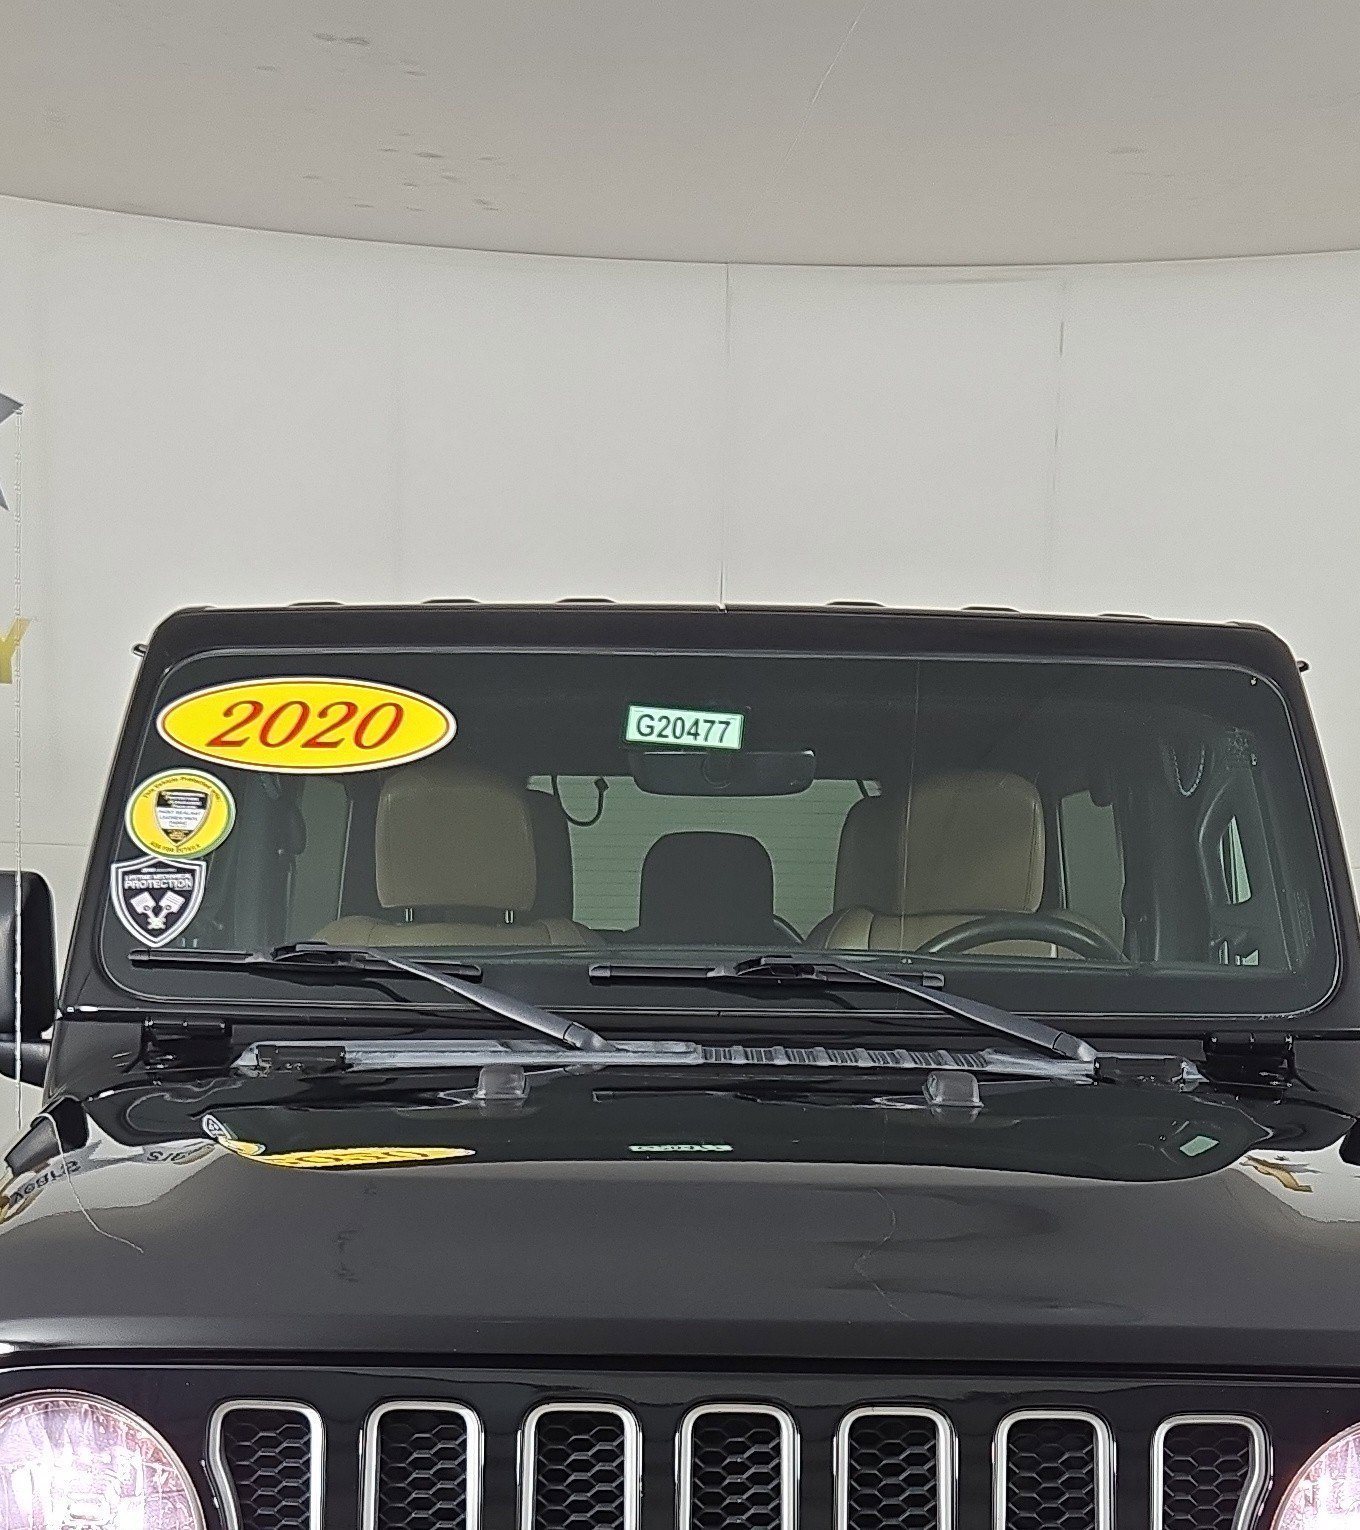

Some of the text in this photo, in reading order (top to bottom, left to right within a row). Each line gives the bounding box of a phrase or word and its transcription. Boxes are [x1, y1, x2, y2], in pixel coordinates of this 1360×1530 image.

[205, 700, 404, 749] 2020
[636, 713, 731, 744] G20477
[124, 880, 193, 890] PROTECTION
